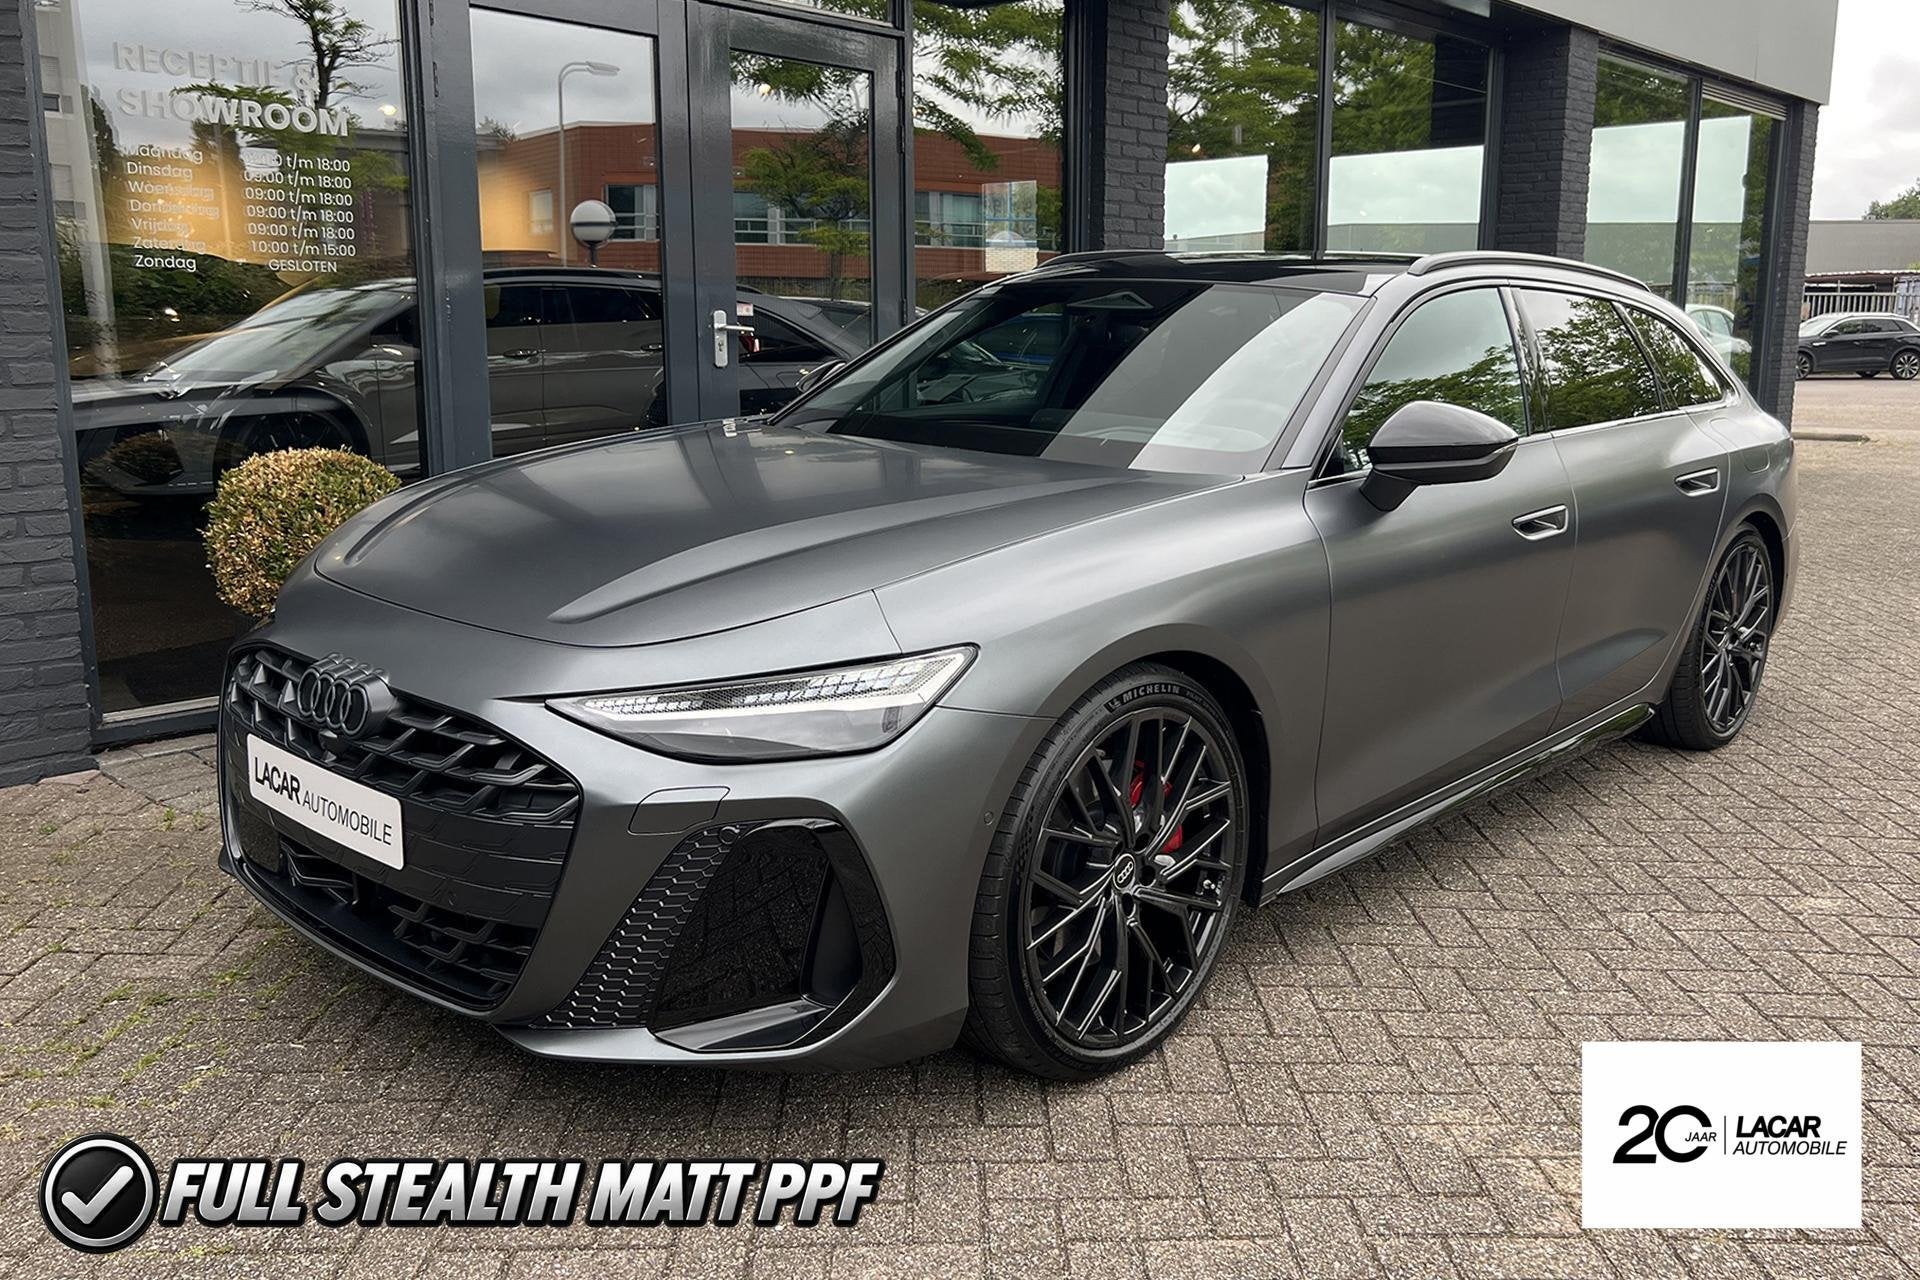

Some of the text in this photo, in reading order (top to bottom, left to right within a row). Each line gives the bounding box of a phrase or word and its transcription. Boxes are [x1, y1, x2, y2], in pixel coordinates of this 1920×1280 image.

[112, 42, 279, 86] RECEPTIE
[116, 88, 349, 137] SHOWROOM
[286, 152, 314, 170] t/m
[317, 157, 351, 172] 18:00
[127, 162, 193, 181] Dinsdag
[287, 170, 315, 187] t/m
[318, 175, 352, 189] 18:00
[245, 187, 286, 201] 09:00
[289, 187, 316, 205] t/m
[319, 192, 353, 206] 18:00
[246, 205, 287, 219] 09:00
[290, 205, 317, 222] t/m
[320, 209, 354, 223] 18:00
[248, 223, 288, 237] 09:00
[291, 222, 318, 239] t/m
[321, 227, 355, 240] 18:00
[250, 240, 289, 254] 10:00
[293, 240, 320, 257] t/m
[322, 243, 356, 257] 15:00
[134, 254, 338, 273] Zondag GESLOTEN
[1122, 684, 1180, 704] MICHELIN
[254, 757, 393, 846] LACAR AUTOMOBILE
